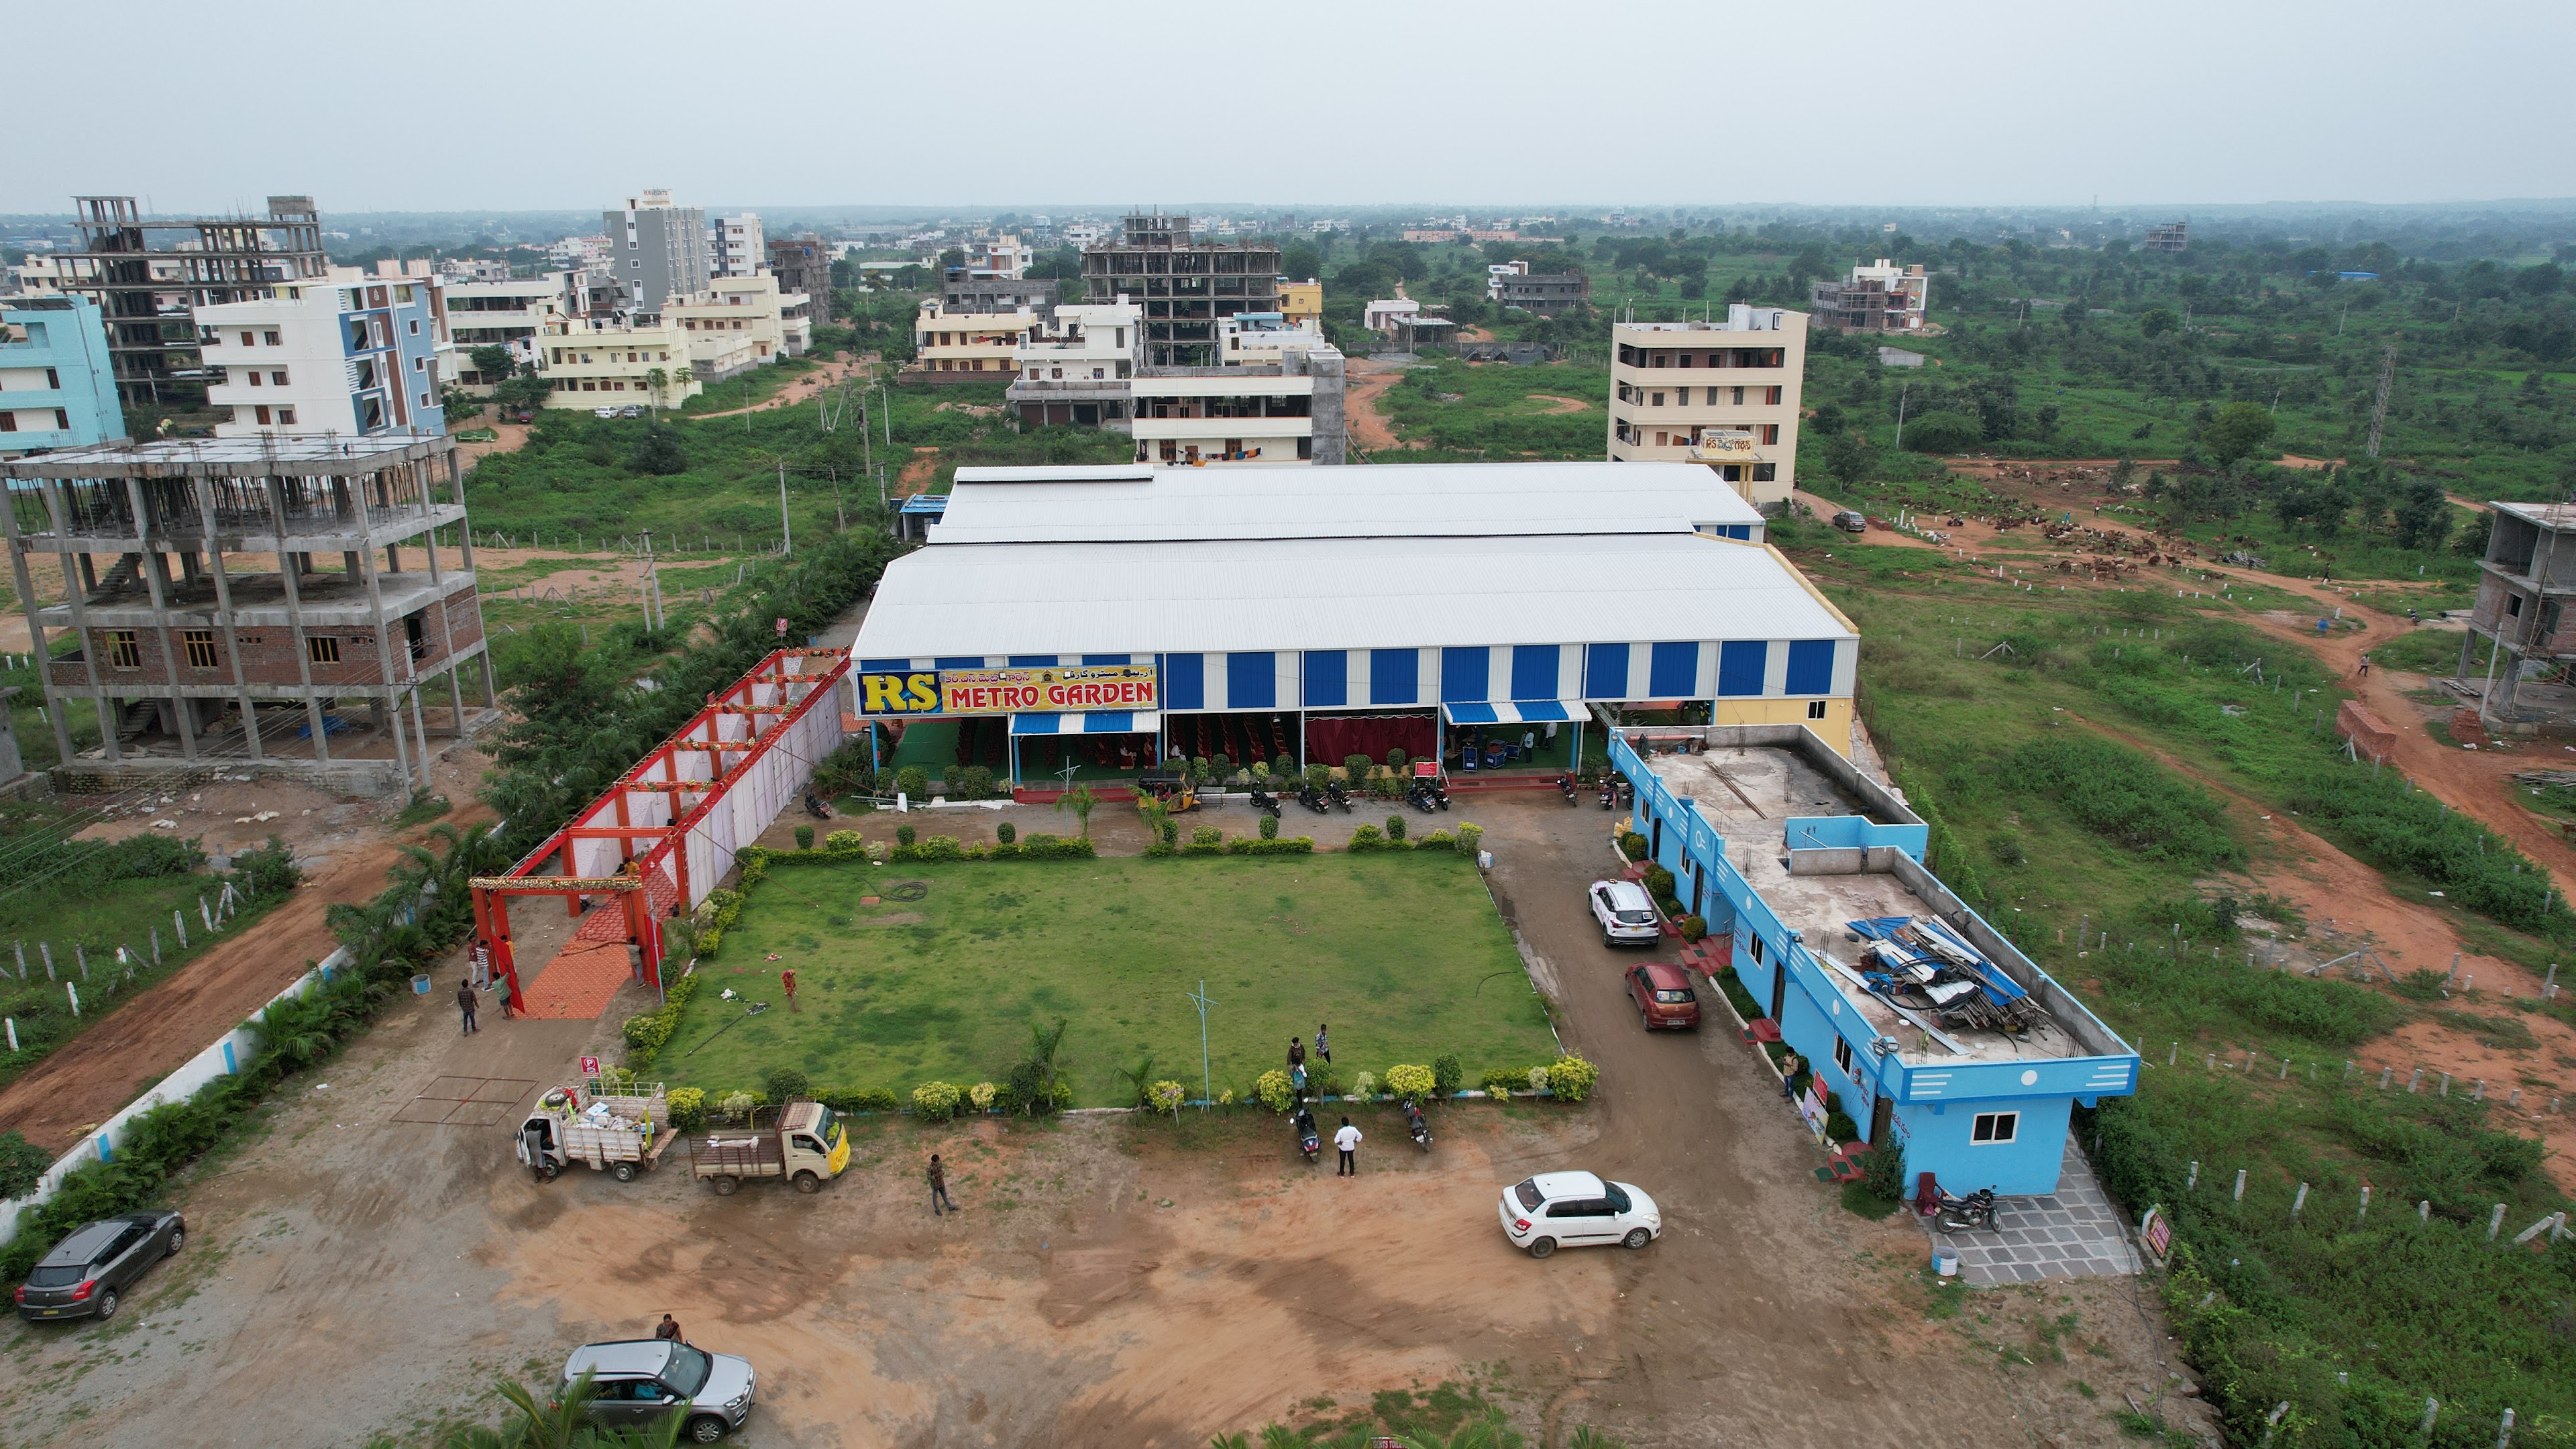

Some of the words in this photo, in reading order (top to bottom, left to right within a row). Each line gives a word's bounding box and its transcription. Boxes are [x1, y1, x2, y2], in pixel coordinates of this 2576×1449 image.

[1706, 439, 1717, 449] RS
[863, 674, 938, 711] RS
[951, 686, 1040, 708] METRO
[1048, 682, 1153, 707] GARDEN
